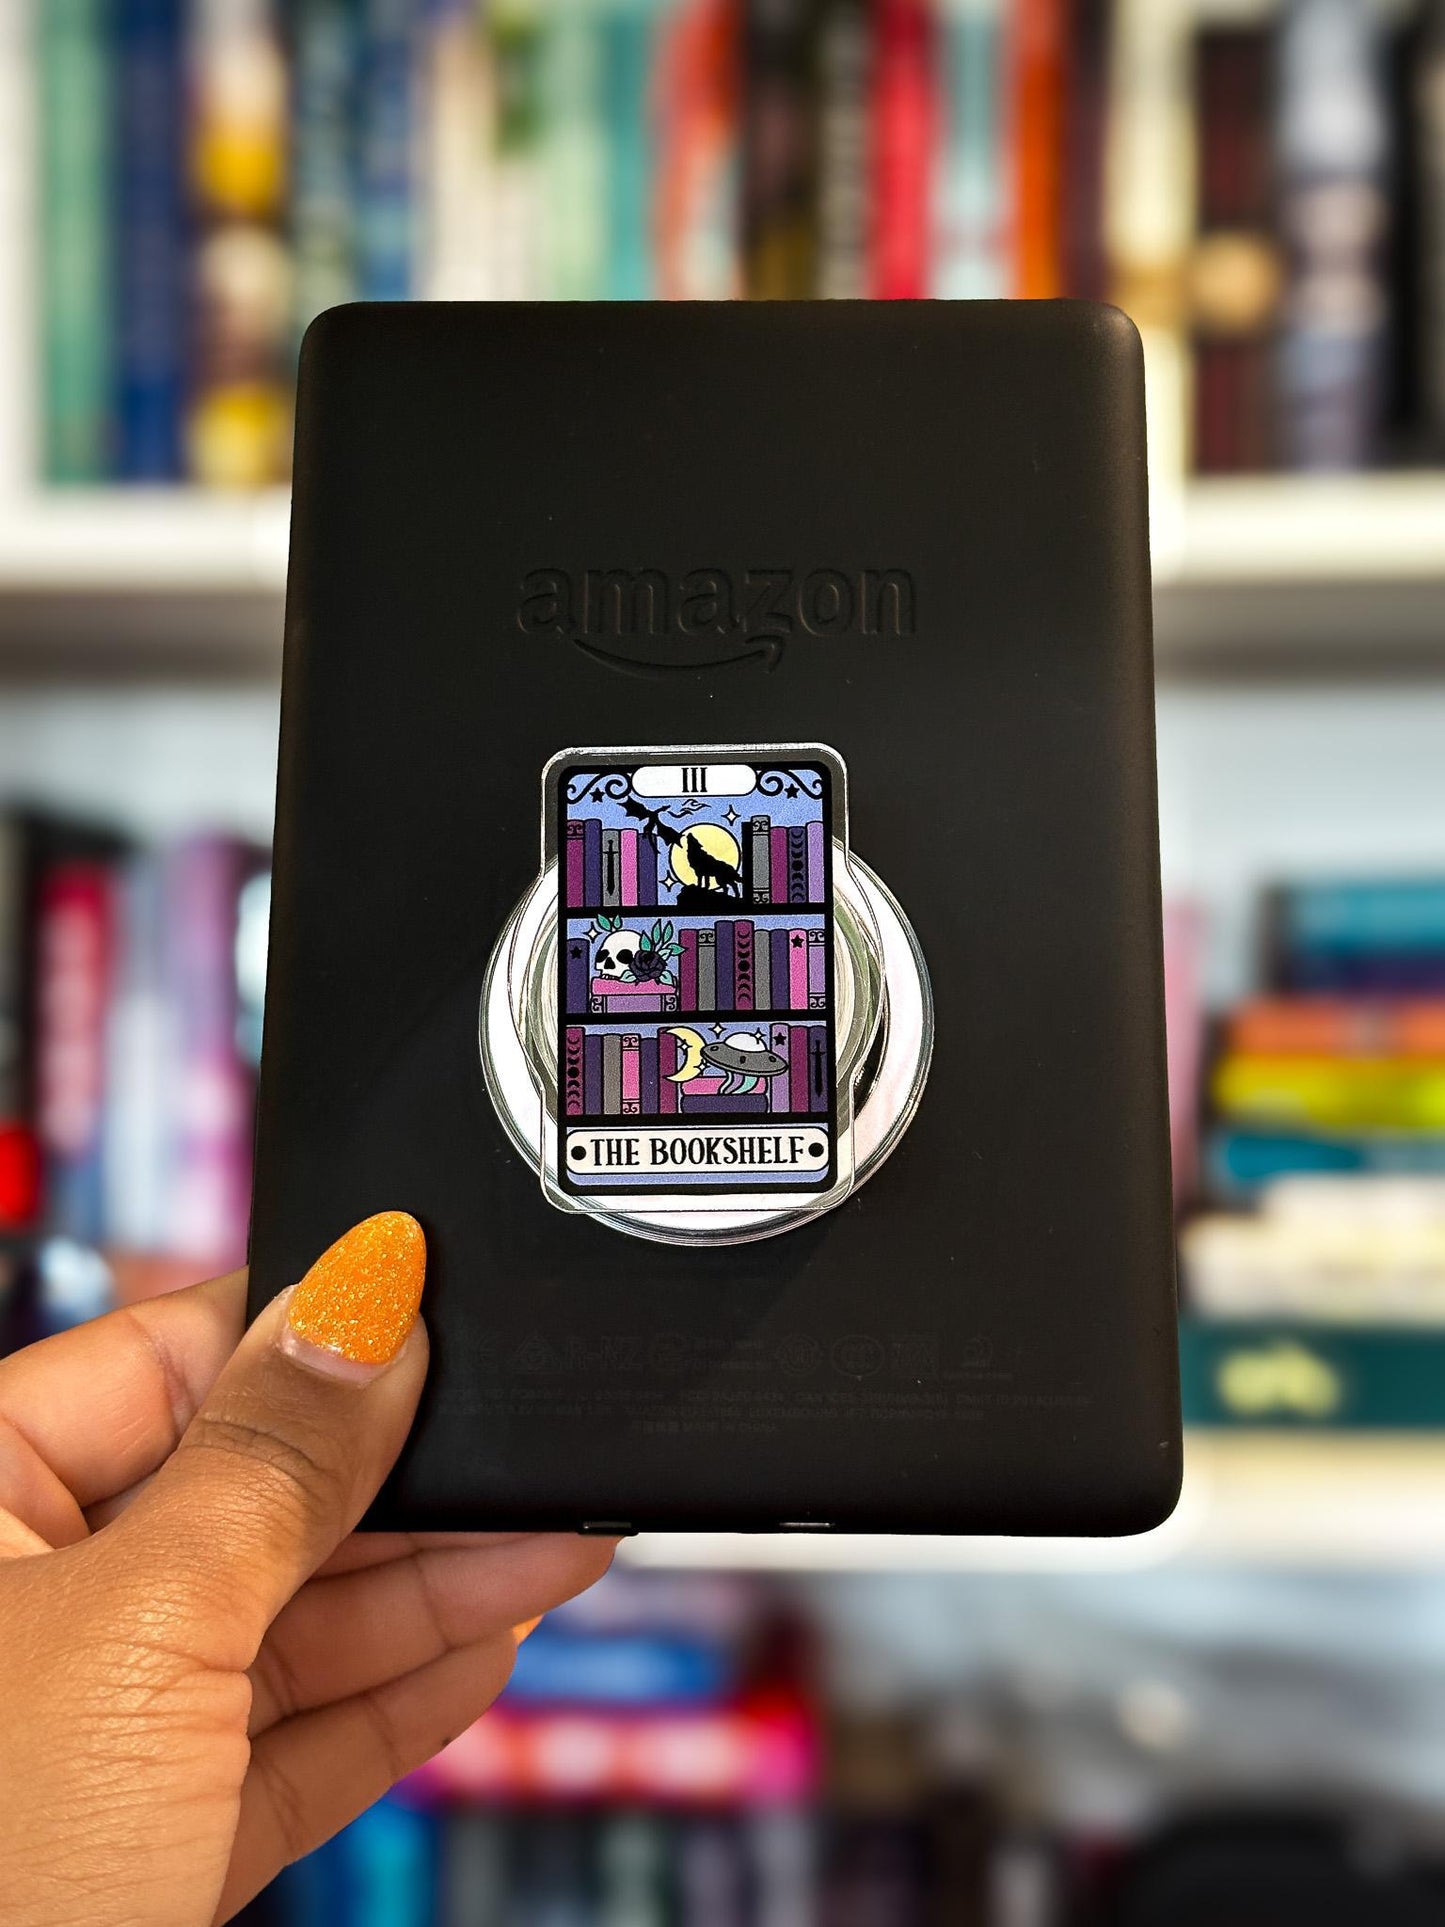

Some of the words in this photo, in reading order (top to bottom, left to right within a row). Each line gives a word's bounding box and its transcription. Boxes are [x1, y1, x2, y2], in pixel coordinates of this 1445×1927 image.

[516, 568, 918, 636] amazon
[681, 767, 708, 793] III
[590, 1138, 640, 1166] THE
[649, 1136, 805, 1165] BOOKSHELF
